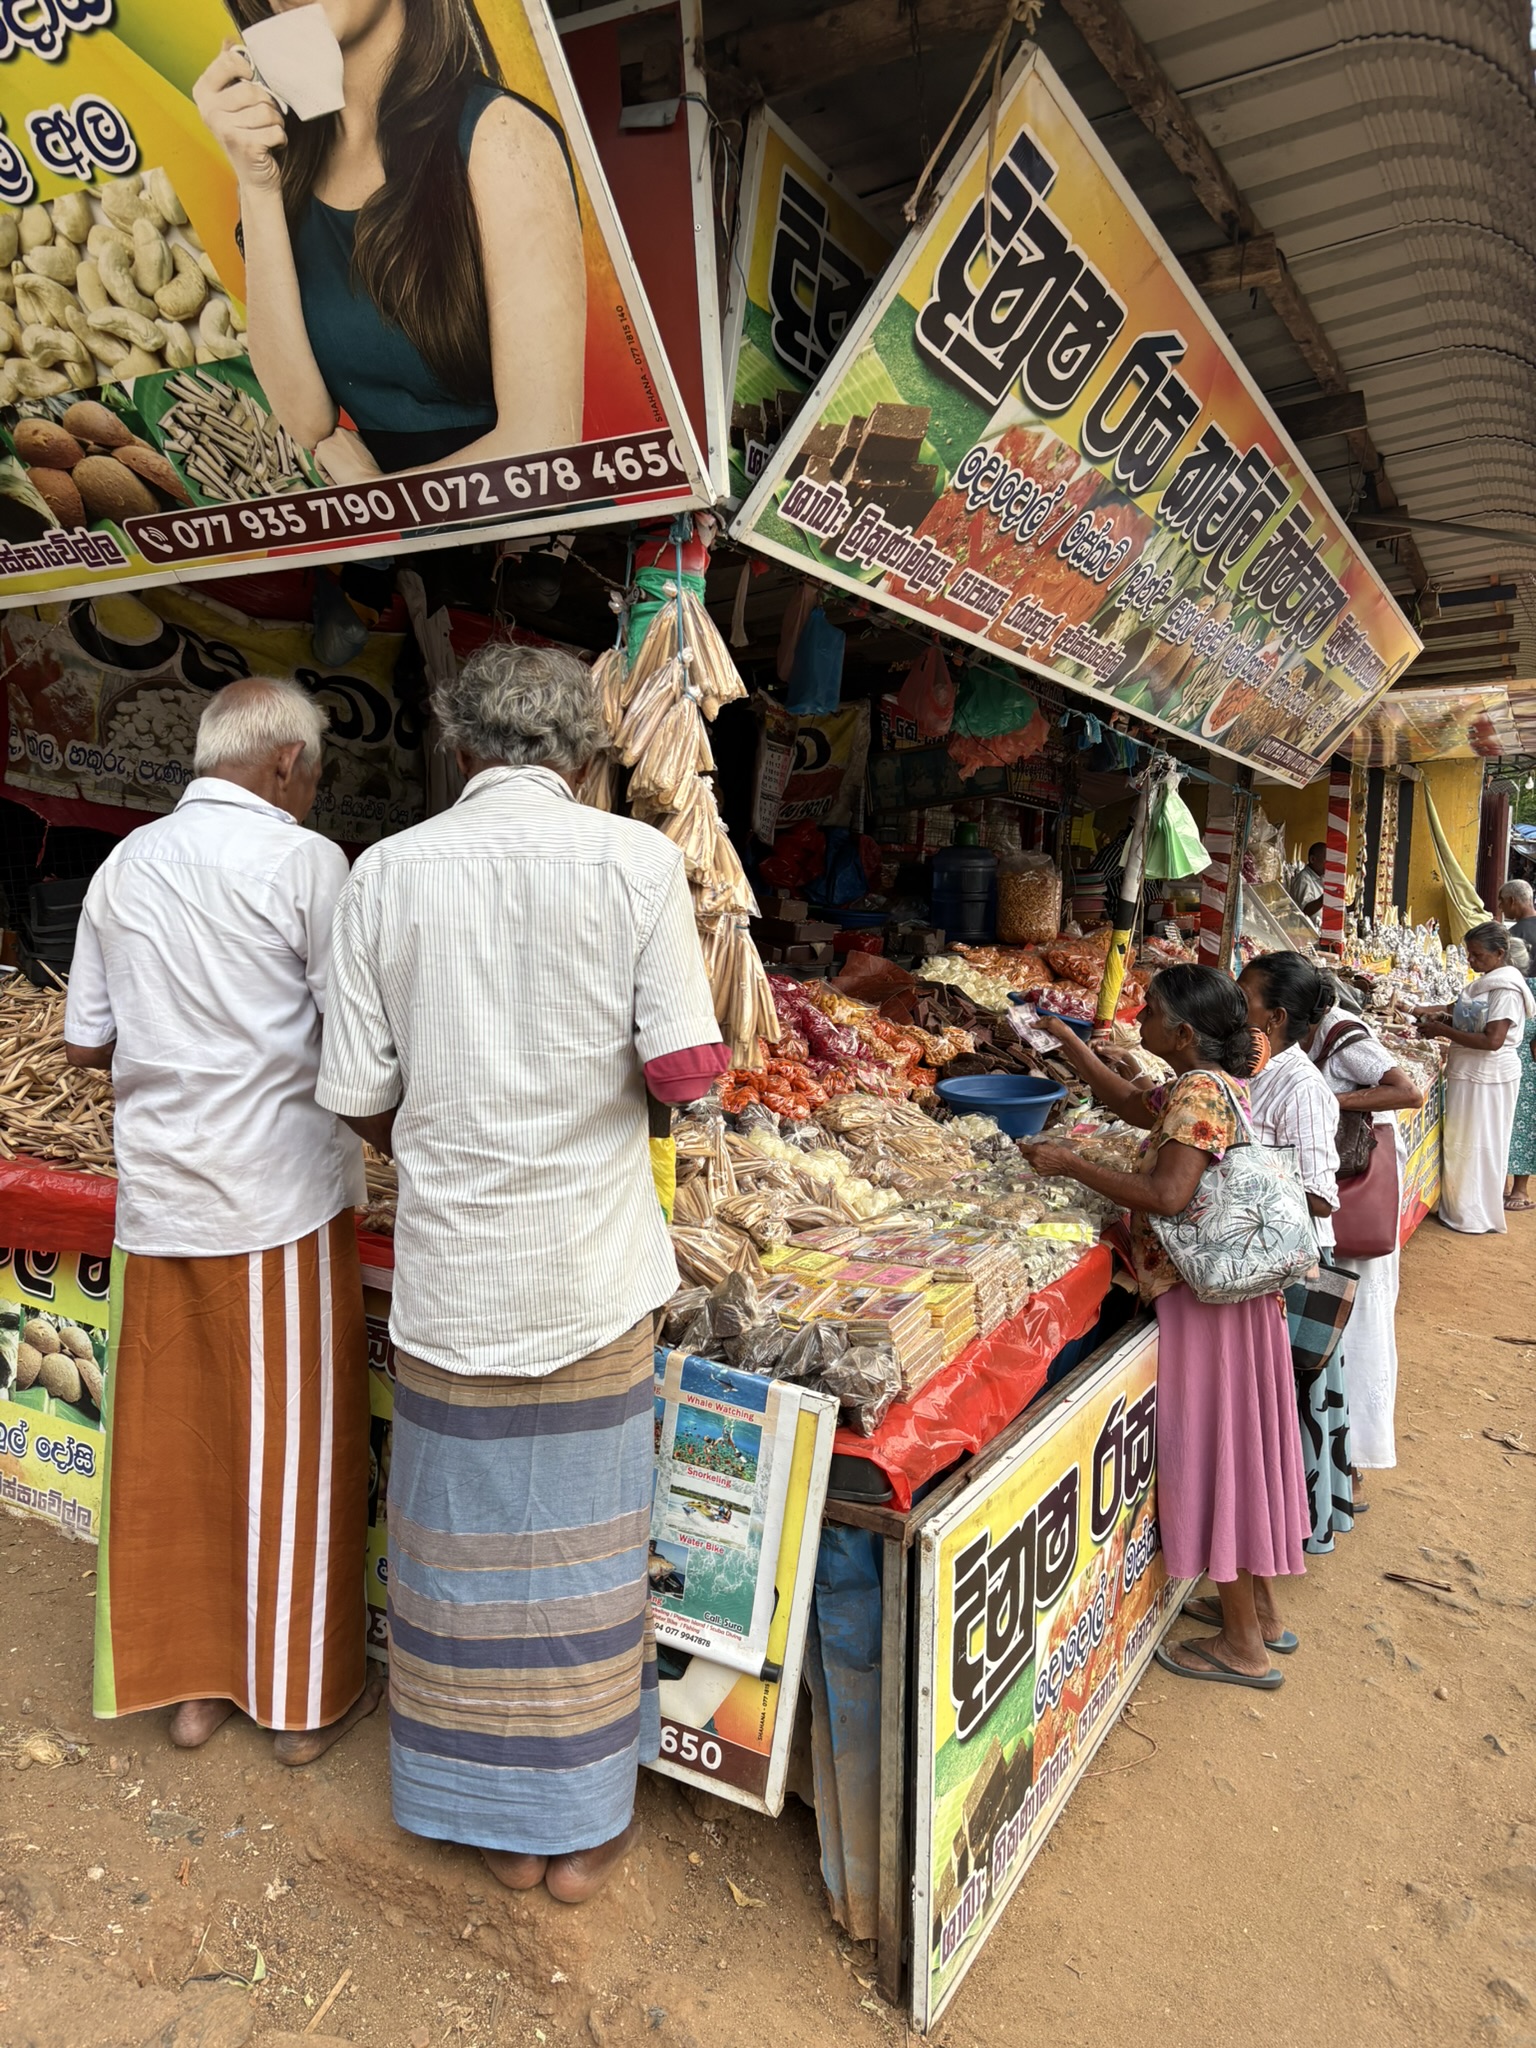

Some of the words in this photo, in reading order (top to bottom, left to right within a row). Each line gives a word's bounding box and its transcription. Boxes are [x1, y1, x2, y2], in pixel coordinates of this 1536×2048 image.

[31, 100, 130, 174] අල
[616, 305, 627, 323] 140
[622, 325, 635, 345] 1815
[630, 347, 642, 365] 077
[641, 375, 663, 423] SHAHANA
[171, 514, 233, 552] 077
[245, 503, 307, 540] 935
[308, 489, 396, 530] 7190
[422, 472, 499, 513] 072
[504, 456, 581, 499] 678
[1086, 339, 1200, 486] රස
[1240, 504, 1348, 649] නිෂ්පාදන
[956, 445, 1066, 539] දොදොල්
[1059, 513, 1132, 581] මස්කට්
[1158, 597, 1213, 643] පුහුල්
[686, 1394, 713, 1409] Whale
[715, 1402, 755, 1422] Watching
[687, 1467, 732, 1488] Snorkeling
[679, 1533, 704, 1548] Water
[705, 1542, 725, 1554] Bike
[1124, 1513, 1161, 1595] මස්ක
[704, 1612, 722, 1625] Call:
[724, 1618, 743, 1632] Sura
[665, 1626, 679, 1637] 077
[681, 1631, 711, 1648] 9947878
[758, 1712, 766, 1741] SHAHANA
[660, 1725, 722, 1771] 650
